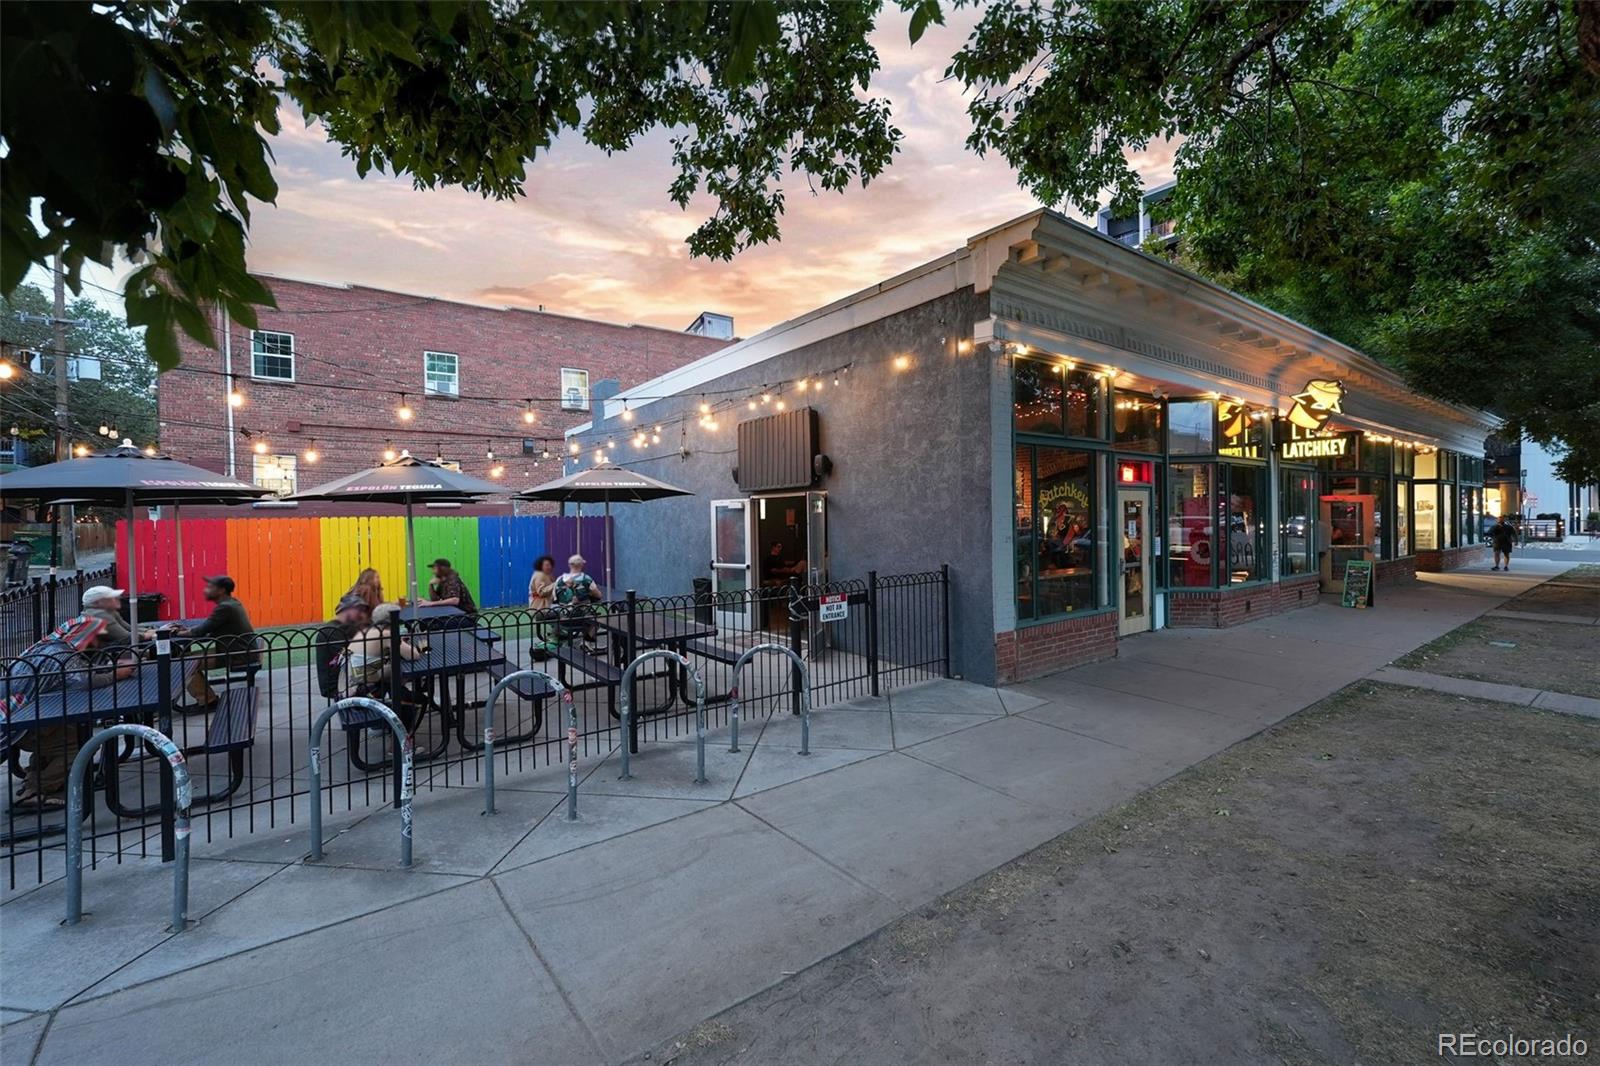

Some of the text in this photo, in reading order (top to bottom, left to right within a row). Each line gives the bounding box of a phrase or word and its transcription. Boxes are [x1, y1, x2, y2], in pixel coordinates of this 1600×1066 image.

[1282, 438, 1347, 459] LATCHKEY
[1038, 481, 1089, 509] Latchkey
[822, 611, 845, 620] ENTRANCE
